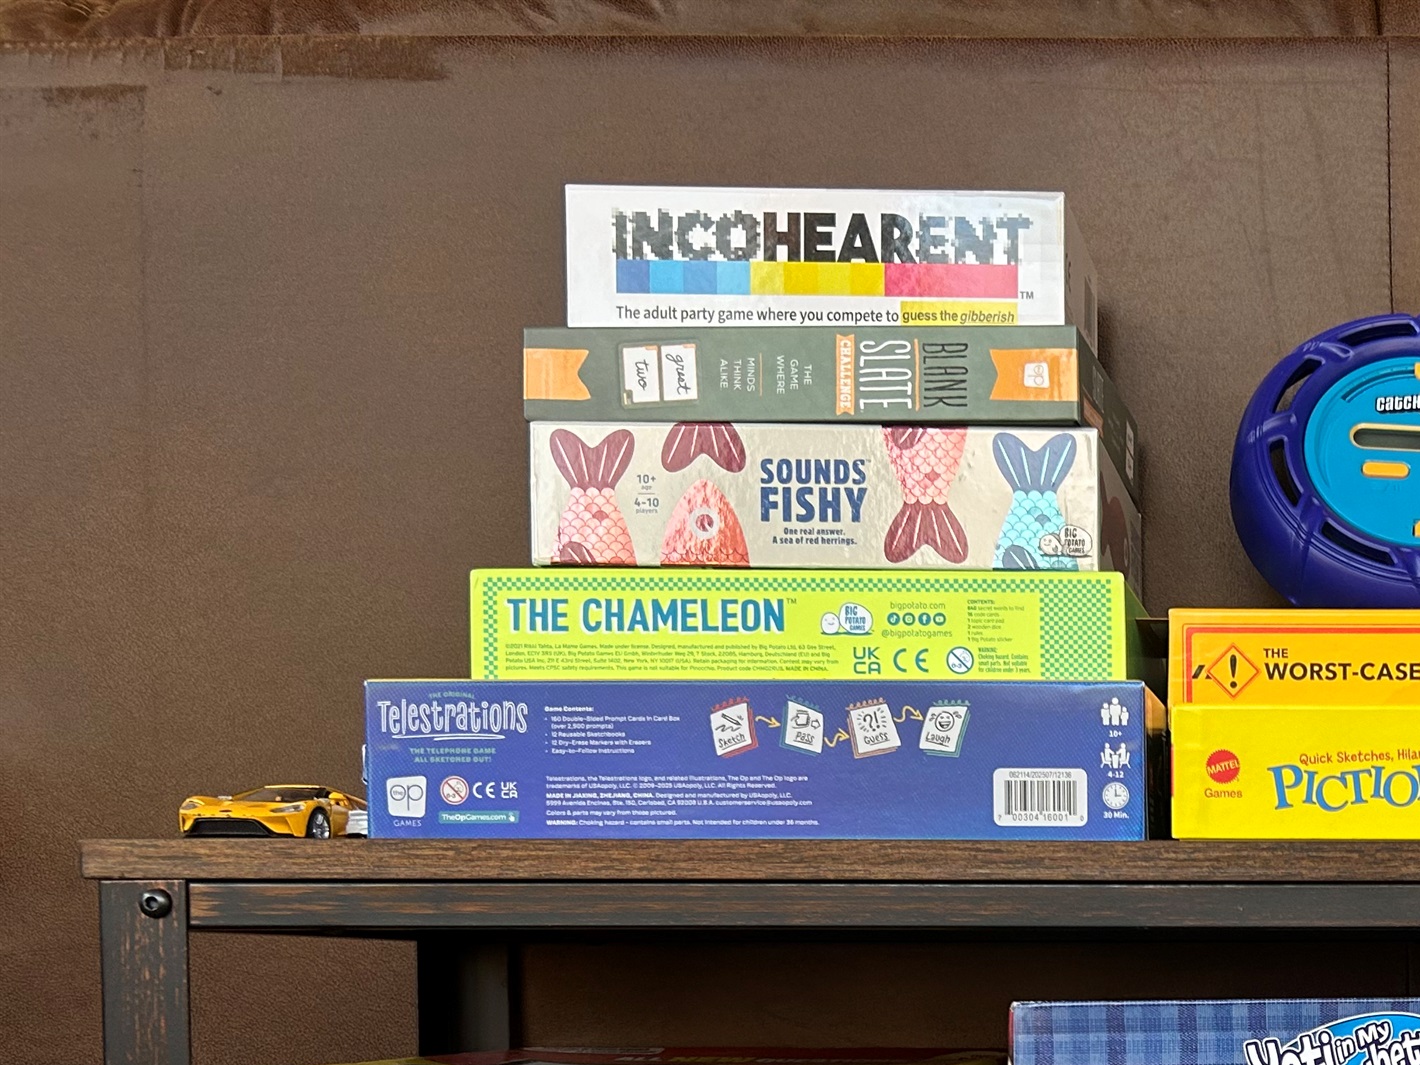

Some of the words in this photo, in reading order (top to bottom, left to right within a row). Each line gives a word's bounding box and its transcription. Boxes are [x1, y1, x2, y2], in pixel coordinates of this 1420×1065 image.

[612, 208, 1033, 264] INCOHEARENT
[616, 305, 641, 320] The
[644, 305, 678, 321] adult
[681, 307, 715, 325] party
[718, 310, 753, 325] game
[756, 307, 797, 322] where
[800, 311, 824, 326] you
[827, 309, 883, 326] compete
[886, 309, 900, 323] to
[903, 311, 937, 326] guess
[940, 309, 957, 323] the
[960, 308, 1015, 326] gibberish
[635, 359, 648, 391] two
[665, 353, 691, 395] great
[720, 358, 728, 389] ALIKE
[733, 359, 742, 390] THINK
[747, 357, 755, 392] MINDS
[777, 355, 785, 394] WHERE
[790, 359, 799, 390] GAME
[804, 364, 812, 385] THE
[839, 339, 851, 409] CHALLENGE
[859, 340, 912, 410] SLATE
[922, 342, 969, 408] BLANK
[636, 474, 657, 484] 10+
[760, 458, 867, 485] SOUNDS
[634, 498, 660, 508] 4-10
[760, 486, 868, 523] FISHY
[772, 537, 778, 545] A
[779, 537, 793, 545] sea
[795, 536, 804, 545] of
[806, 536, 819, 545] red
[821, 536, 858, 546] herrings.
[783, 527, 798, 536] One
[800, 527, 815, 536] real
[816, 528, 846, 536] answer.
[507, 598, 569, 632] THE
[582, 597, 785, 632] CHAMELEON
[889, 601, 946, 611] bigpotato.com
[881, 629, 953, 638] @bigpotatogames
[1263, 648, 1289, 659] THE
[376, 698, 529, 735] Telestrations
[718, 733, 746, 747] Sketch
[796, 731, 815, 743] Pass
[925, 732, 951, 745] Laugh
[1206, 758, 1240, 774] MATTEL
[1299, 752, 1334, 767] Quick
[1336, 750, 1394, 765] Sketches,
[393, 819, 422, 827] GAMES
[441, 813, 507, 822] TheOpGames.com
[1336, 1036, 1358, 1064] in
[1357, 1019, 1391, 1048] My
